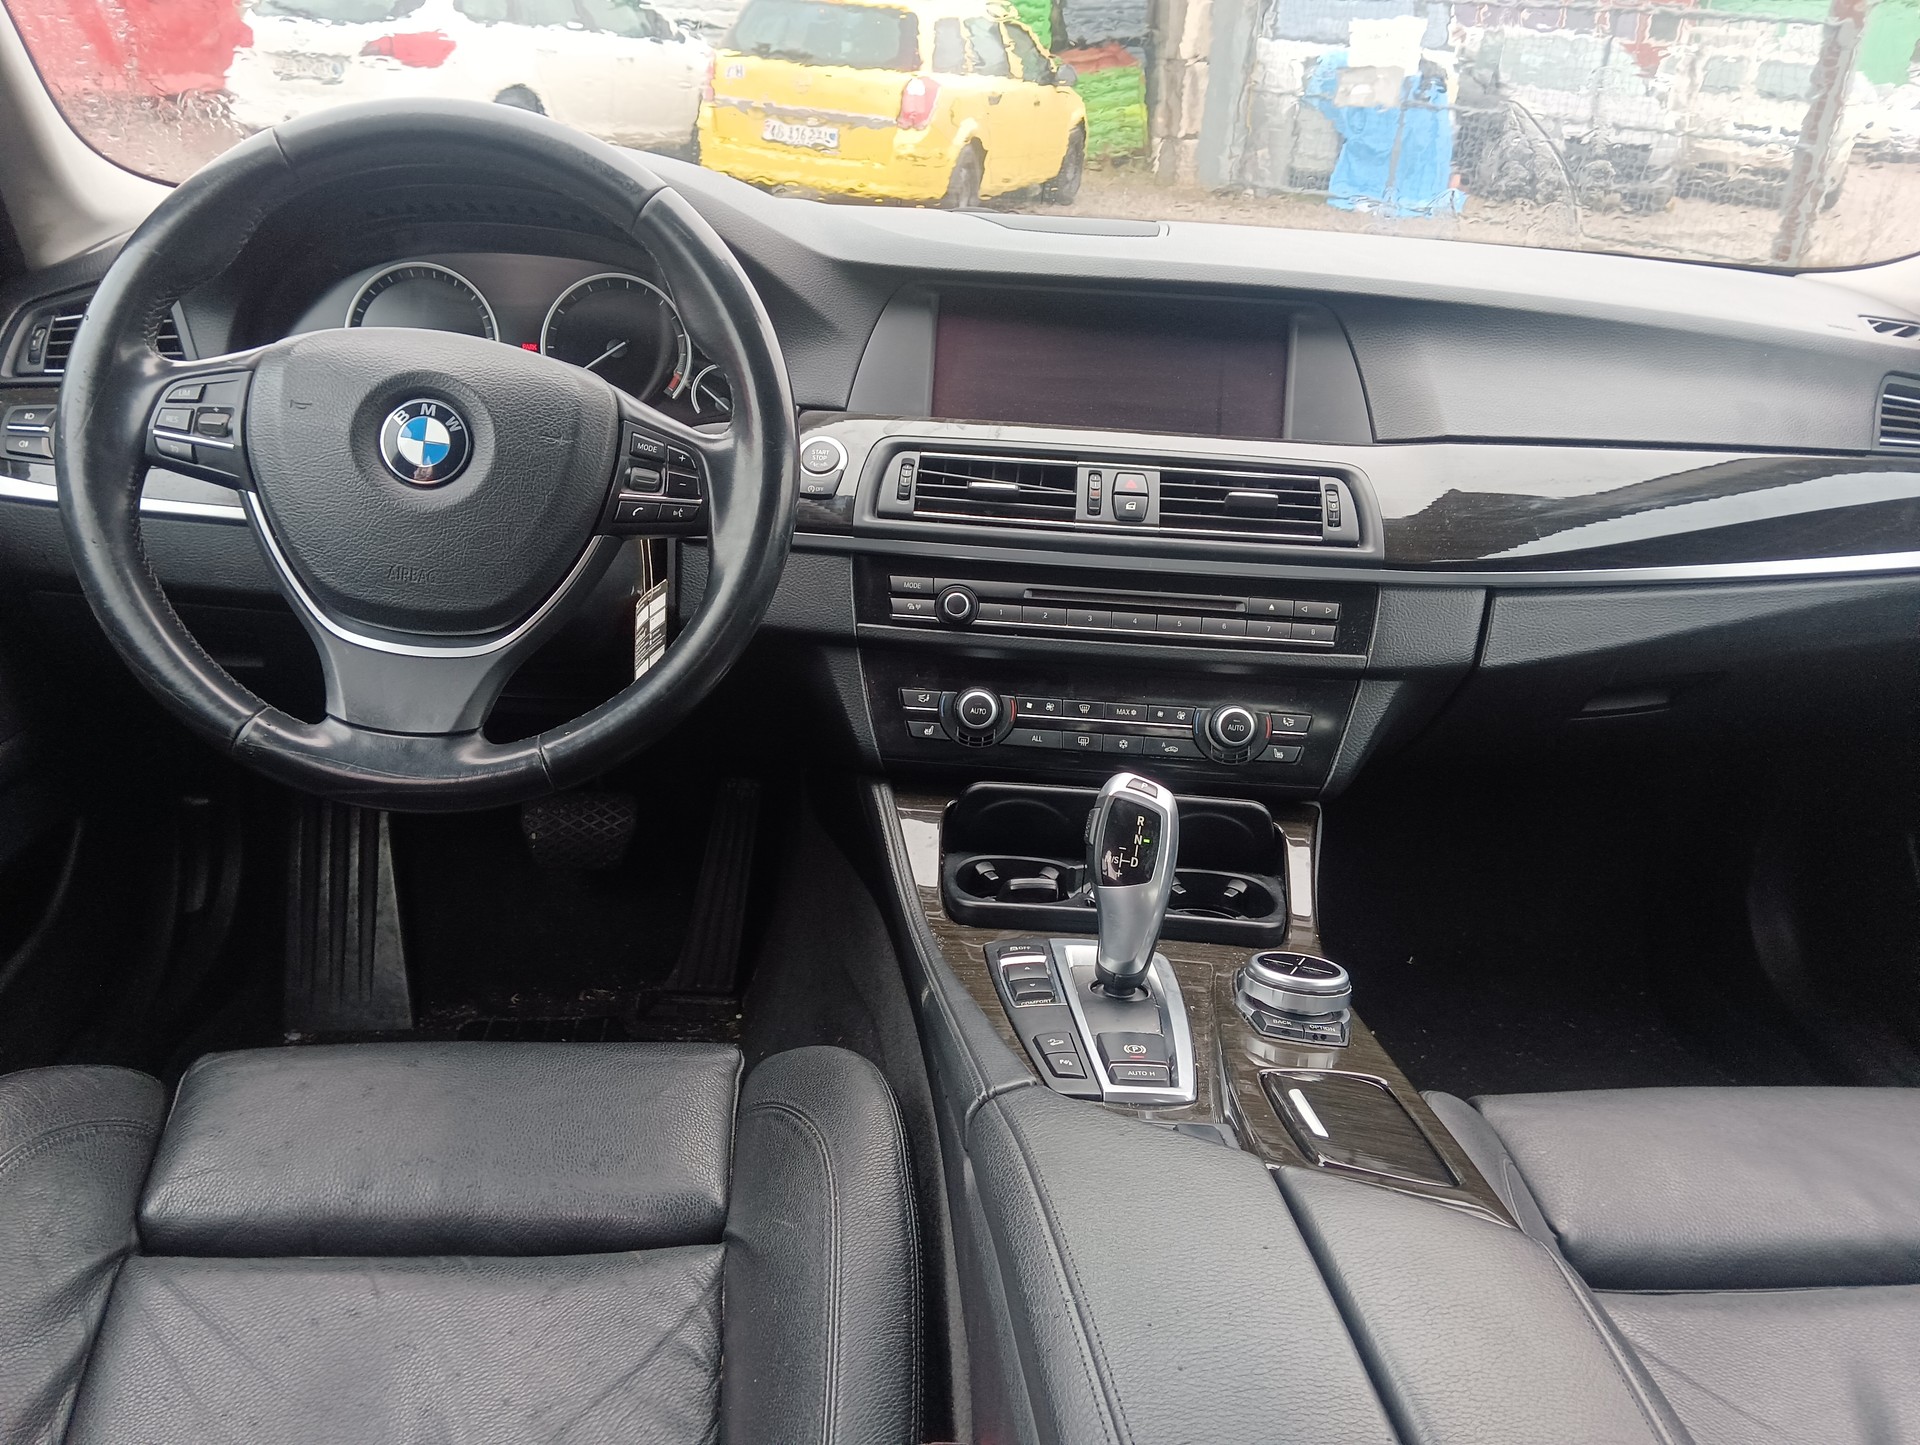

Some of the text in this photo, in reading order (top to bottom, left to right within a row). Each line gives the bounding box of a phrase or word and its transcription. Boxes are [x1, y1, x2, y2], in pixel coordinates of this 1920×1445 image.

[521, 343, 538, 351] PARK
[178, 389, 191, 397] LIM
[165, 414, 179, 424] RES
[392, 403, 462, 433] BMW
[637, 442, 658, 453] MODE
[903, 581, 922, 589] MODE
[970, 707, 987, 715] AUTO
[1116, 708, 1130, 716] MAX
[1227, 724, 1245, 732] AUTO
[1031, 735, 1043, 743] ALL
[1137, 815, 1145, 826] R
[1134, 834, 1143, 845] N
[1130, 857, 1139, 868] D
[1020, 998, 1052, 1006] COMFORT
[1309, 1024, 1336, 1032] OPTION
